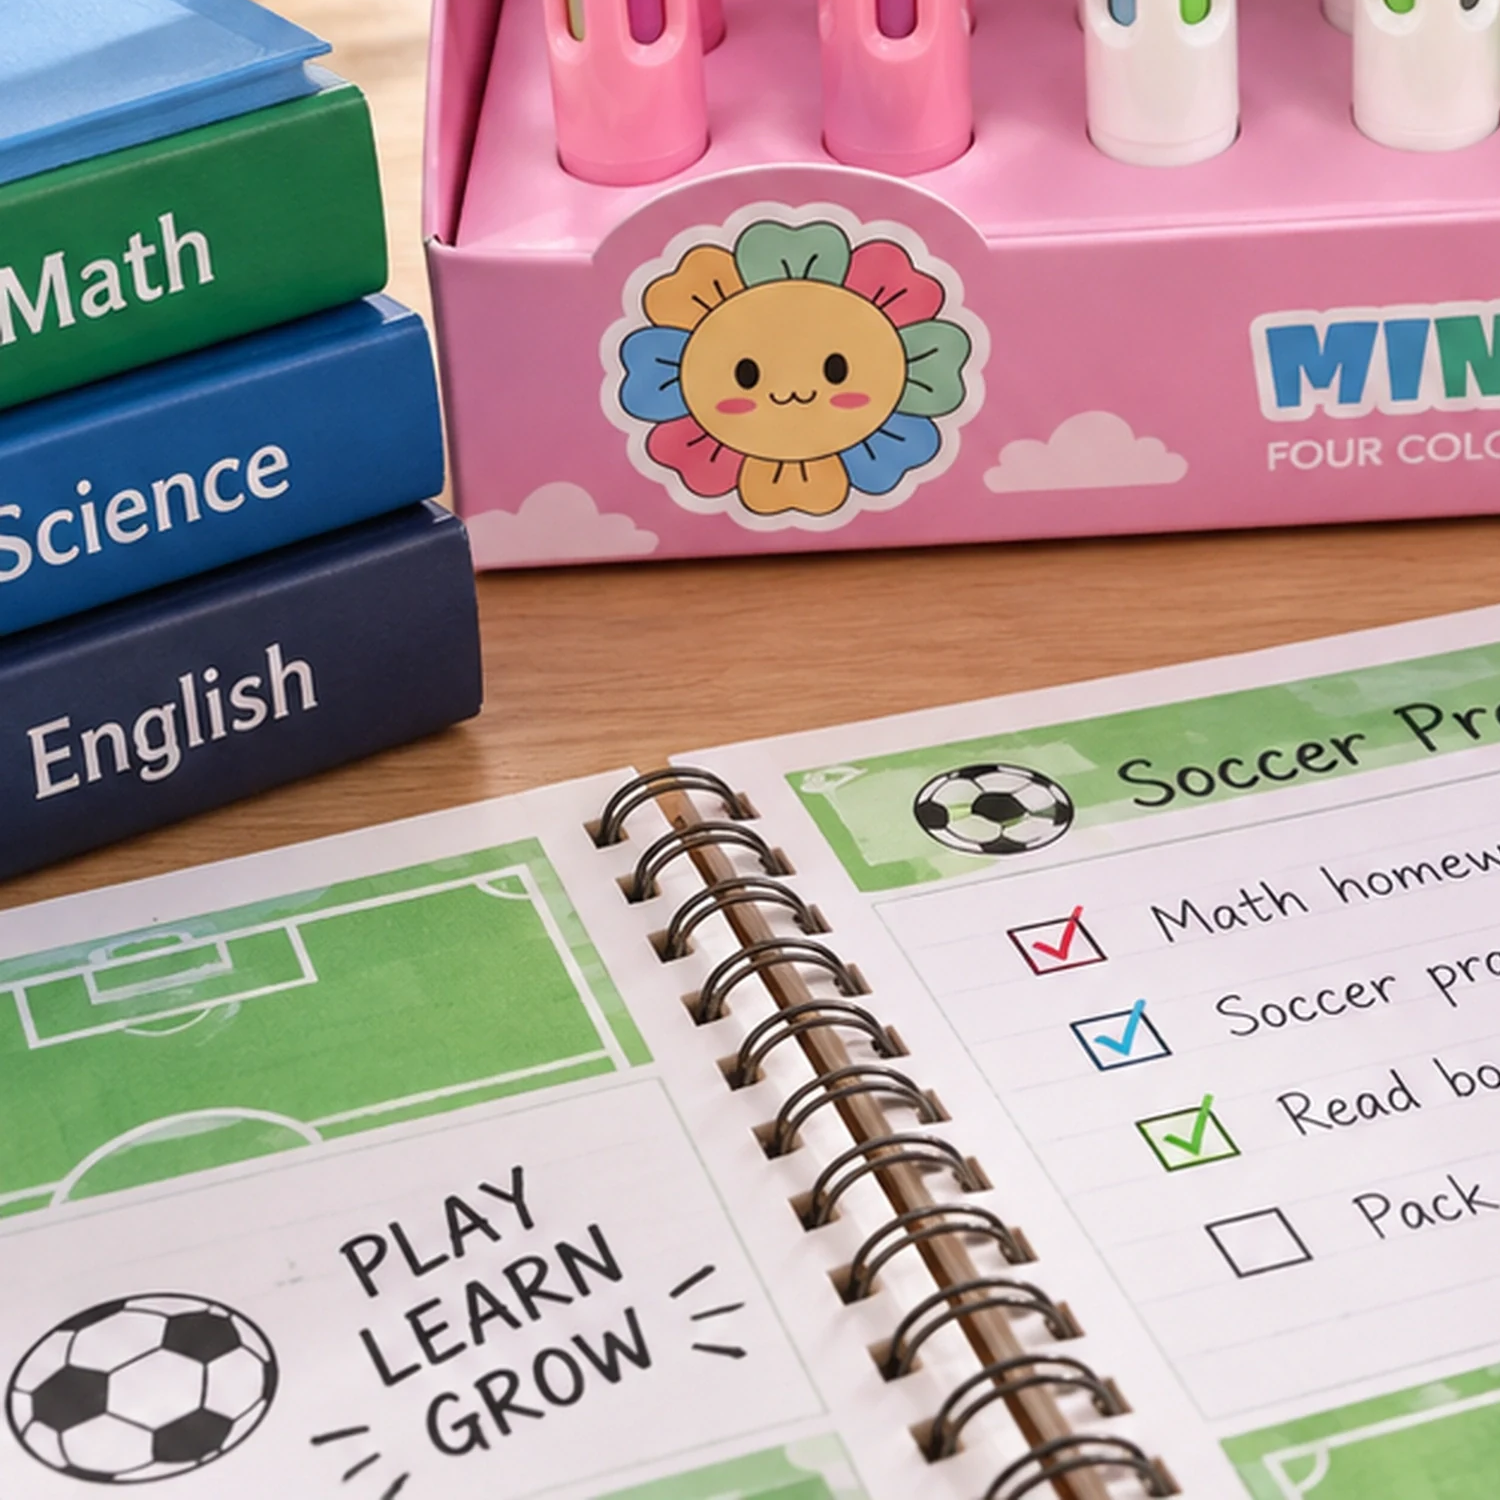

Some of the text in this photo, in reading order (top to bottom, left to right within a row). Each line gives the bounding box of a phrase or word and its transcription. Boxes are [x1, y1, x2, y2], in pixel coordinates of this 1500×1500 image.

[0, 211, 215, 345] Math
[1267, 437, 1383, 471] FOUR
[0, 444, 290, 583] Science
[27, 642, 318, 799] English
[1116, 732, 1367, 809] Soccer
[1151, 881, 1307, 943] Math
[1215, 975, 1397, 1038] Soccer
[1278, 1070, 1420, 1136] Read
[340, 1166, 535, 1297] PLAY
[1353, 1175, 1500, 1240] Pack
[360, 1224, 624, 1387] LEARN
[426, 1307, 652, 1457] GROW
